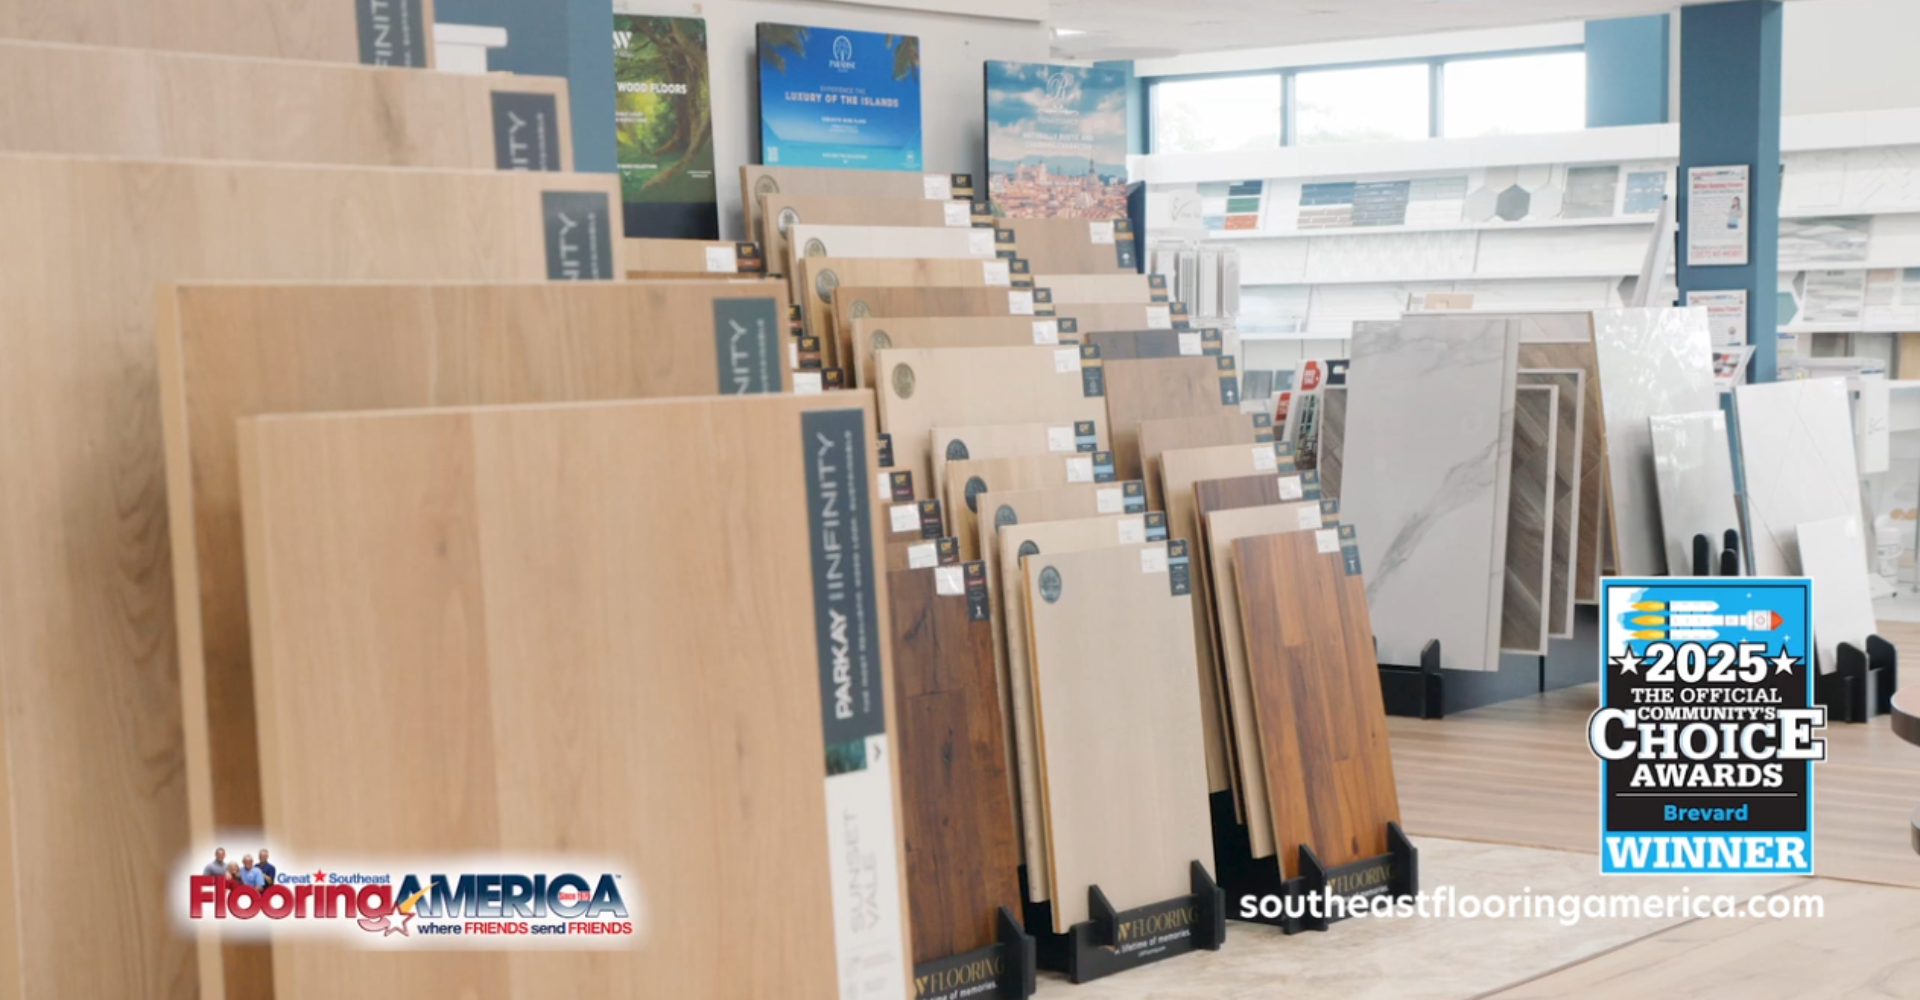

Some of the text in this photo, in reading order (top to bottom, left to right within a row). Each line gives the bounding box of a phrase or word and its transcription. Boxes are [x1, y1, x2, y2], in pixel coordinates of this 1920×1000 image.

[617, 82, 687, 94] WOOD FLOORS
[785, 92, 899, 108] LUXURY OF THE ISLANDS
[829, 609, 853, 719] PARKAY
[1132, 905, 1198, 940] FLOORING
